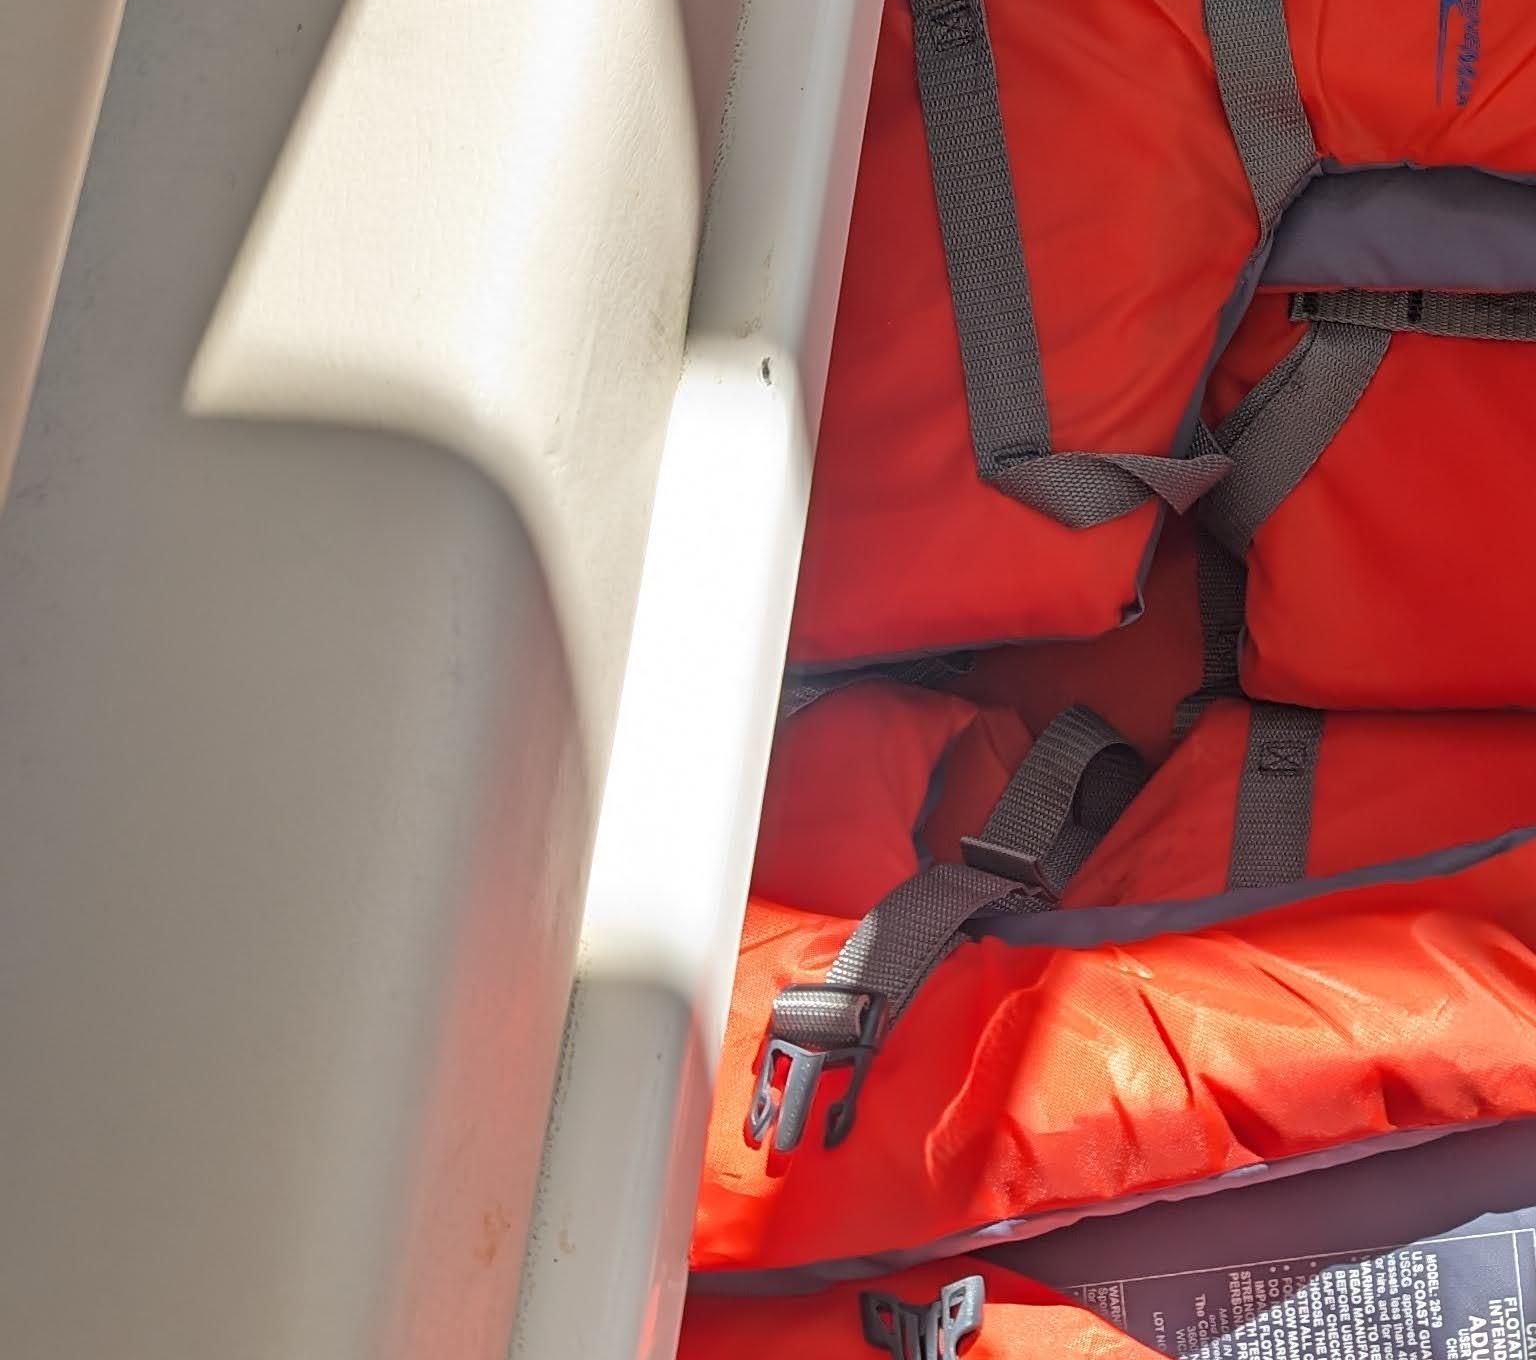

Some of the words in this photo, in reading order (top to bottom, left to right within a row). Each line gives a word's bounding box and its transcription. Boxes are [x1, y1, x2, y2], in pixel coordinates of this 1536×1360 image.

[1399, 1252, 1412, 1287] USCG
[1412, 1251, 1424, 1277] U.S.
[1426, 1255, 1438, 1297] MODEL:
[1268, 1279, 1279, 1297] DO
[1335, 1271, 1350, 1321] BEFORE
[1349, 1269, 1361, 1304] READ
[1375, 1272, 1387, 1297] hire,
[1195, 1294, 1207, 1317] The
[1229, 1272, 1245, 1340] PERSONAL
[1241, 1271, 1257, 1337] STRENGTH
[1296, 1276, 1310, 1324] FASTEN
[1310, 1274, 1322, 1327] CHOOSE
[1378, 1300, 1389, 1321] and
[1391, 1297, 1401, 1320] less
[1414, 1280, 1428, 1326] COAST
[1153, 1312, 1164, 1332] LOT
[1219, 1308, 1231, 1342] MADE
[1368, 1325, 1378, 1341] TO
[1382, 1324, 1392, 1339] for
[1401, 1294, 1419, 1345] approved
[1301, 1326, 1313, 1350] ALL
[1315, 1329, 1326, 1355] THE
[1394, 1323, 1404, 1347] than
[1459, 1329, 1471, 1357] USER
